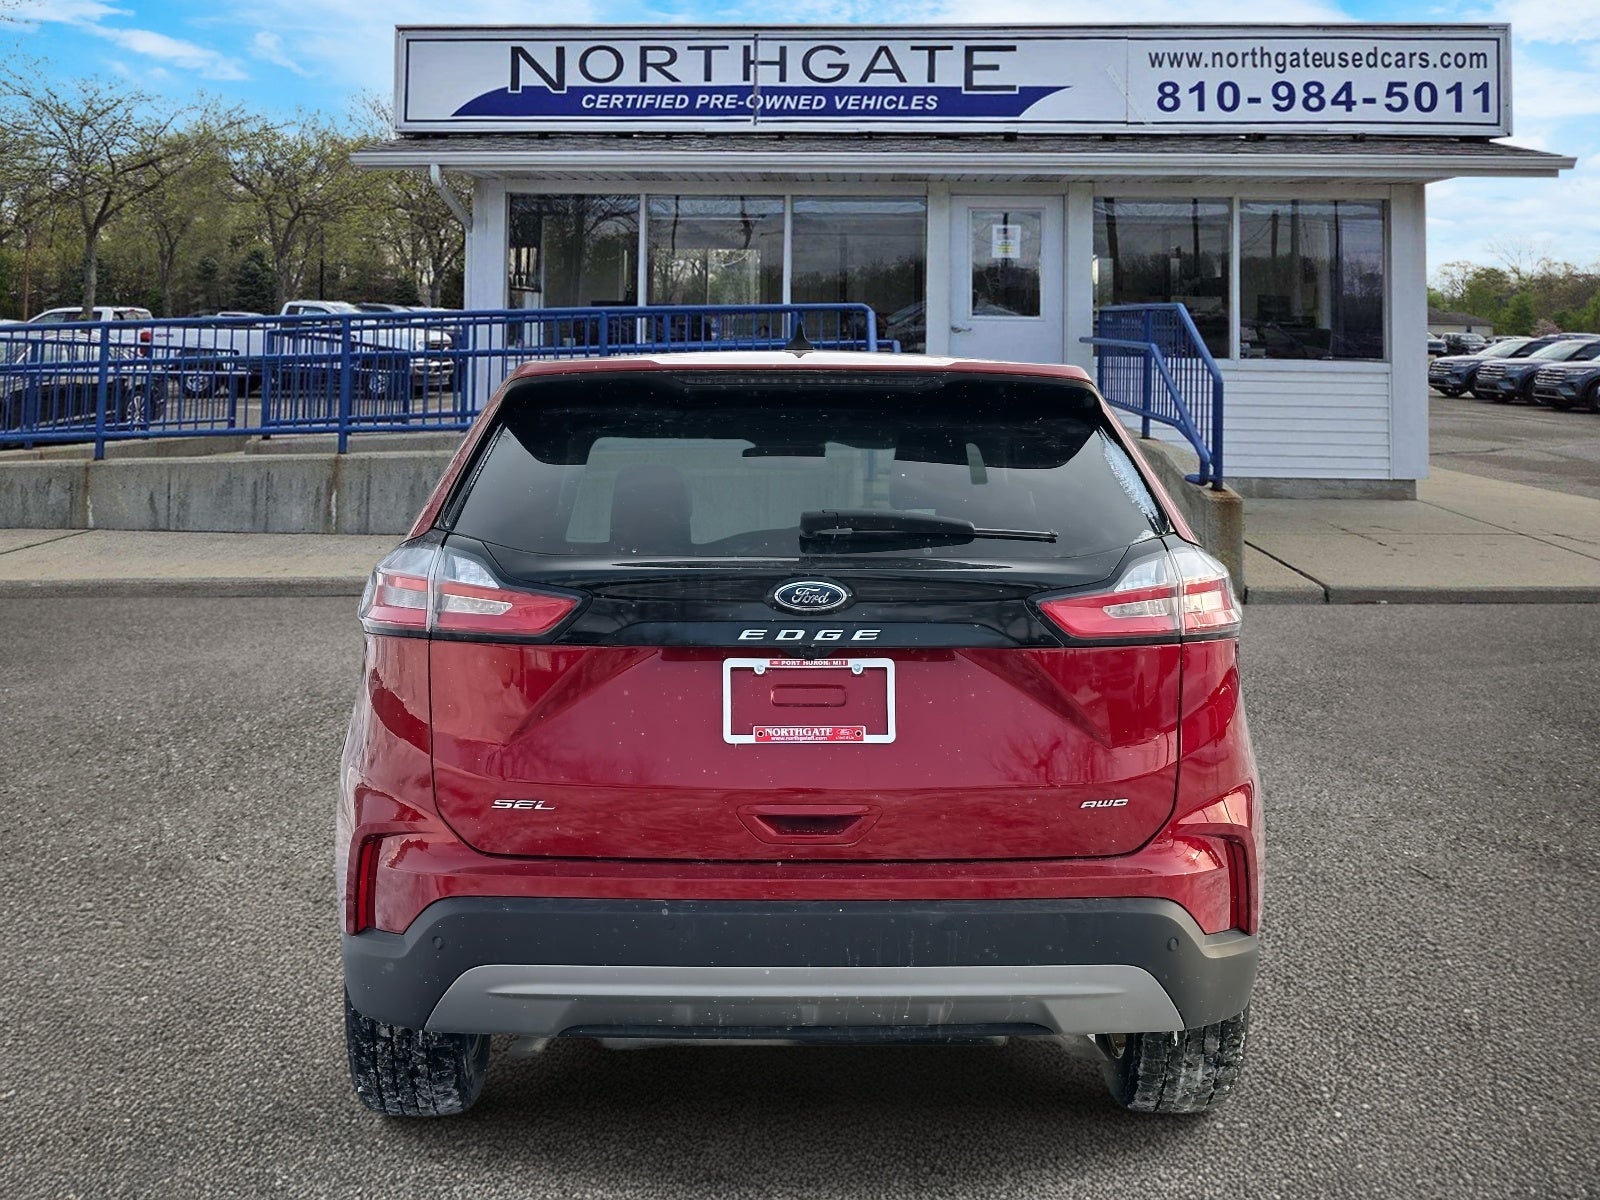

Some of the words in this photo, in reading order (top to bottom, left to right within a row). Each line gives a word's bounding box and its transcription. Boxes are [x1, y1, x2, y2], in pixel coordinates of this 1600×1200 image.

[1148, 46, 1488, 73] www.northgateusedcars.com
[509, 44, 1017, 92] NORTHGATE
[581, 94, 689, 109] CERTIFIED
[695, 94, 827, 110] PRE-OWNED
[834, 95, 938, 110] VEHICLES
[1156, 80, 1491, 113] 810-984-5011
[791, 587, 830, 604] Ford
[737, 629, 882, 641] EDGE
[765, 727, 834, 737] NORTHGATE
[491, 799, 556, 810] SEL
[1080, 798, 1129, 809] AWD
